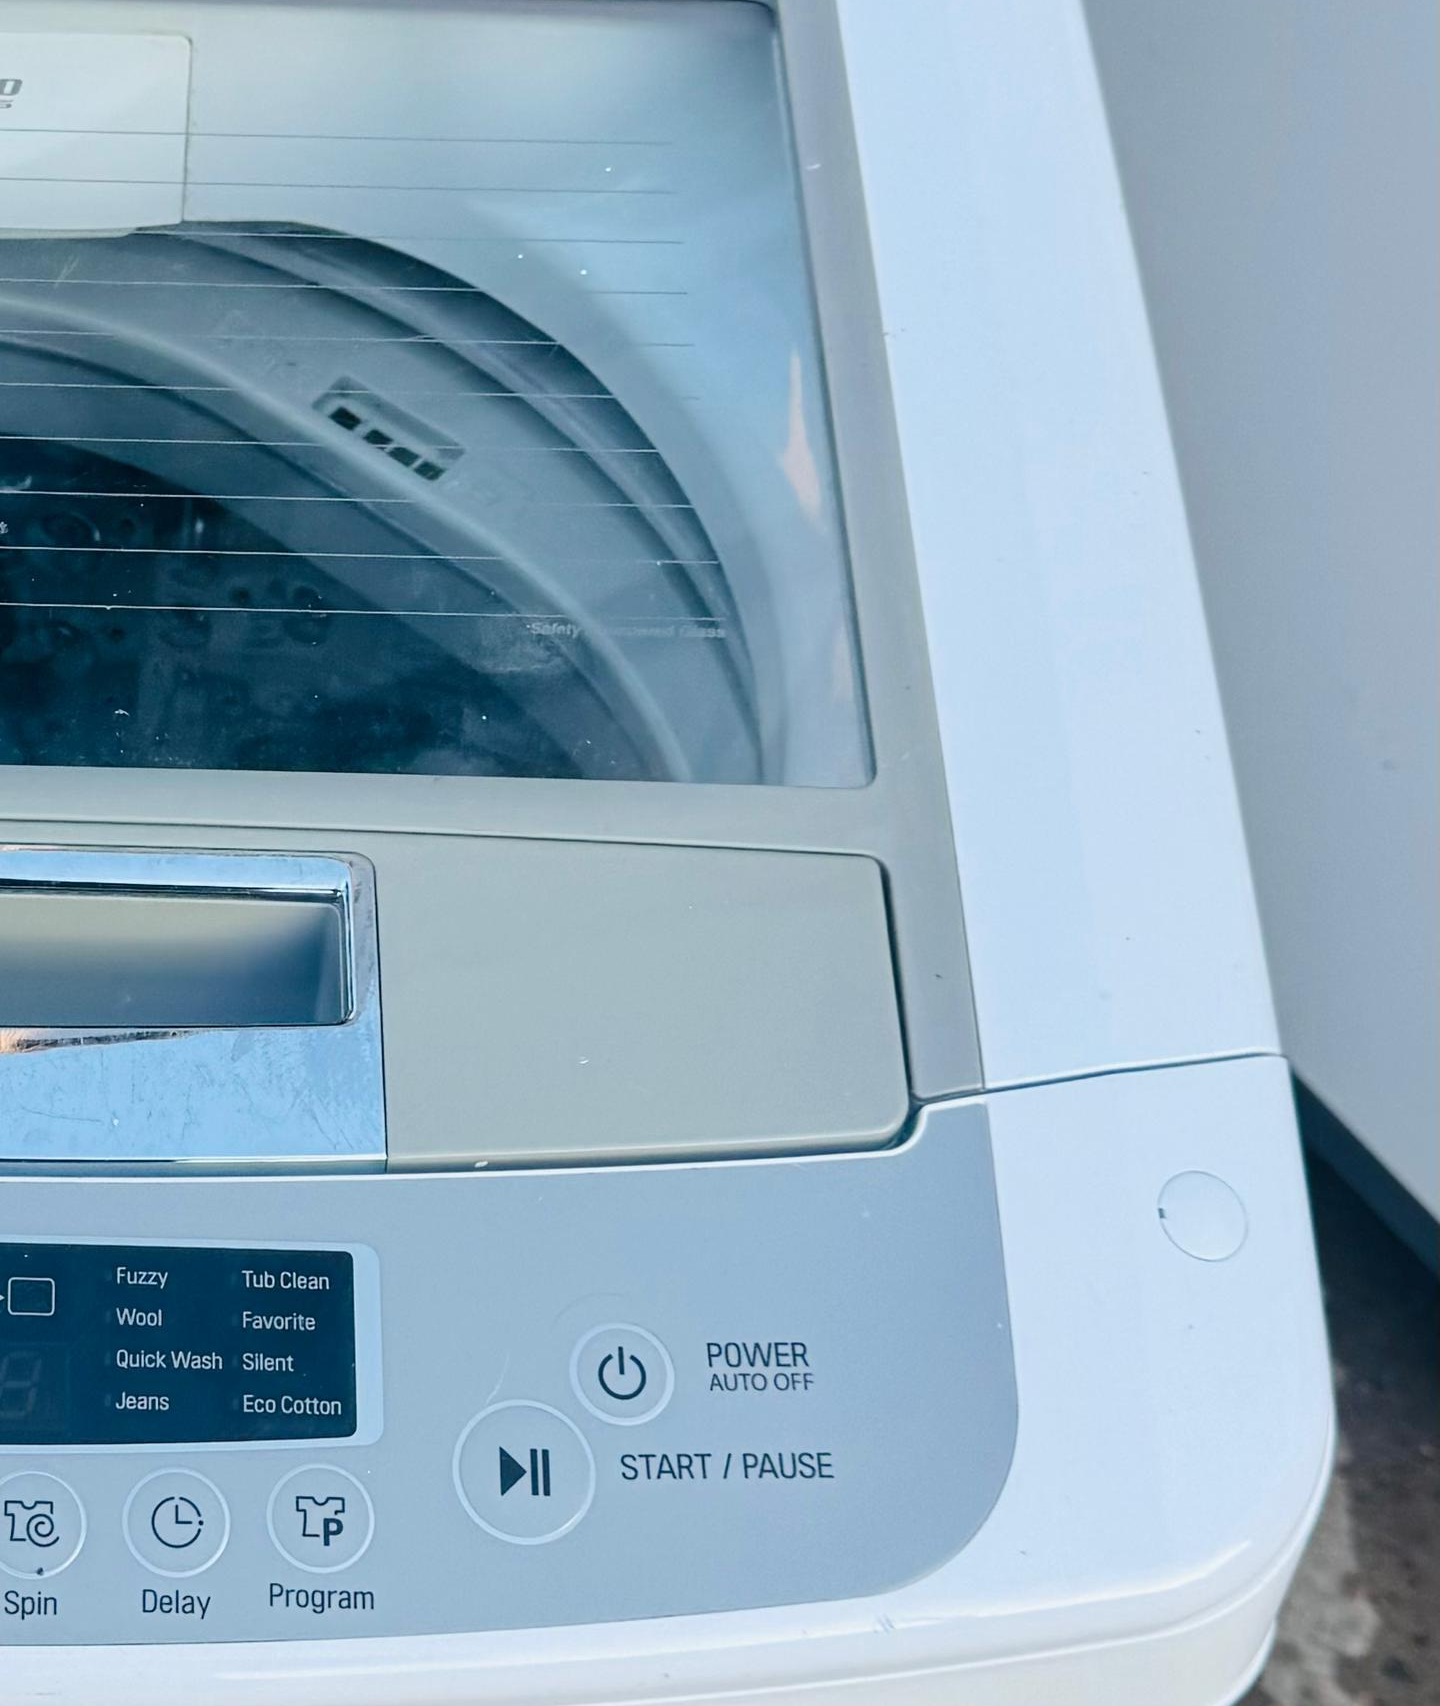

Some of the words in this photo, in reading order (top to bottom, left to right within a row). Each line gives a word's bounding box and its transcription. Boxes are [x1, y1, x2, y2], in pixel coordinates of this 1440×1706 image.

[117, 1267, 168, 1289] Fuzzy
[242, 1270, 275, 1288] Tub
[281, 1272, 329, 1289] Clean
[116, 1308, 162, 1326] Wool
[243, 1311, 315, 1330] Favorite
[117, 1350, 166, 1368] Quick
[171, 1351, 222, 1369] Wash
[243, 1353, 294, 1371] Silent
[707, 1342, 809, 1367] POWER
[710, 1373, 767, 1391] AUTO
[774, 1373, 813, 1391] OFF
[116, 1392, 169, 1410] Jeans
[244, 1395, 276, 1413] Eco
[281, 1396, 341, 1415] Cotton
[621, 1453, 712, 1480] START
[743, 1452, 834, 1479] PAUSE
[5, 1590, 57, 1620] Spin
[143, 1589, 210, 1619] Delay
[270, 1583, 374, 1614] Program
